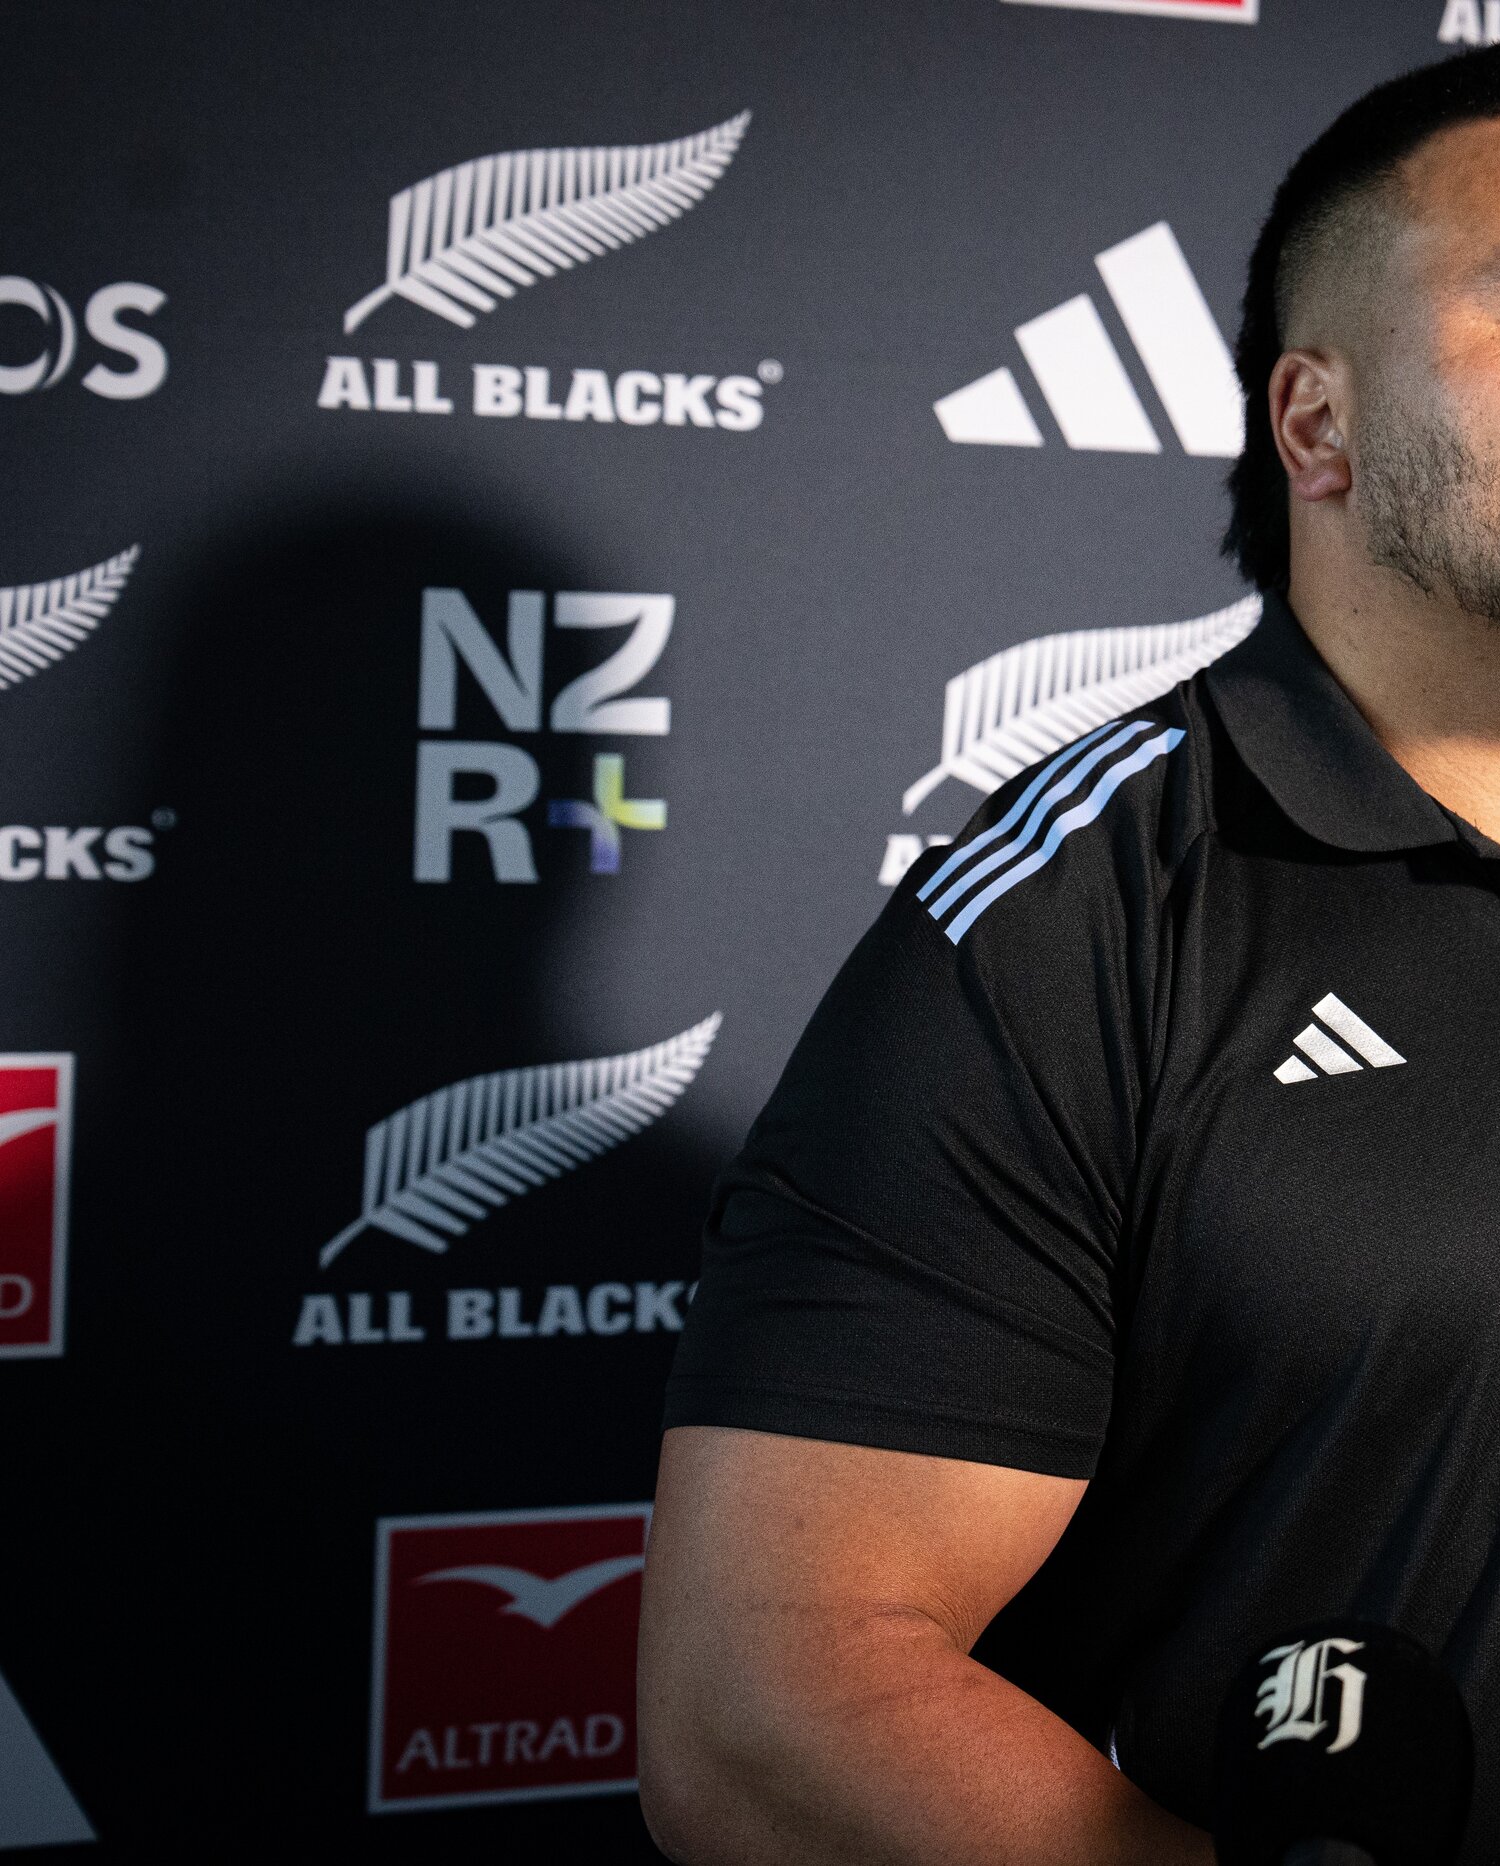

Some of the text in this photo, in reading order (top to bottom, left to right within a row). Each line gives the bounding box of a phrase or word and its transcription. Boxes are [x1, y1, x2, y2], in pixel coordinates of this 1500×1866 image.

[317, 355, 764, 432] ALL BLACKS
[418, 587, 674, 735] NZ
[292, 1281, 699, 1346] ALL BLACK
[396, 1713, 625, 1774] ALTRAD
